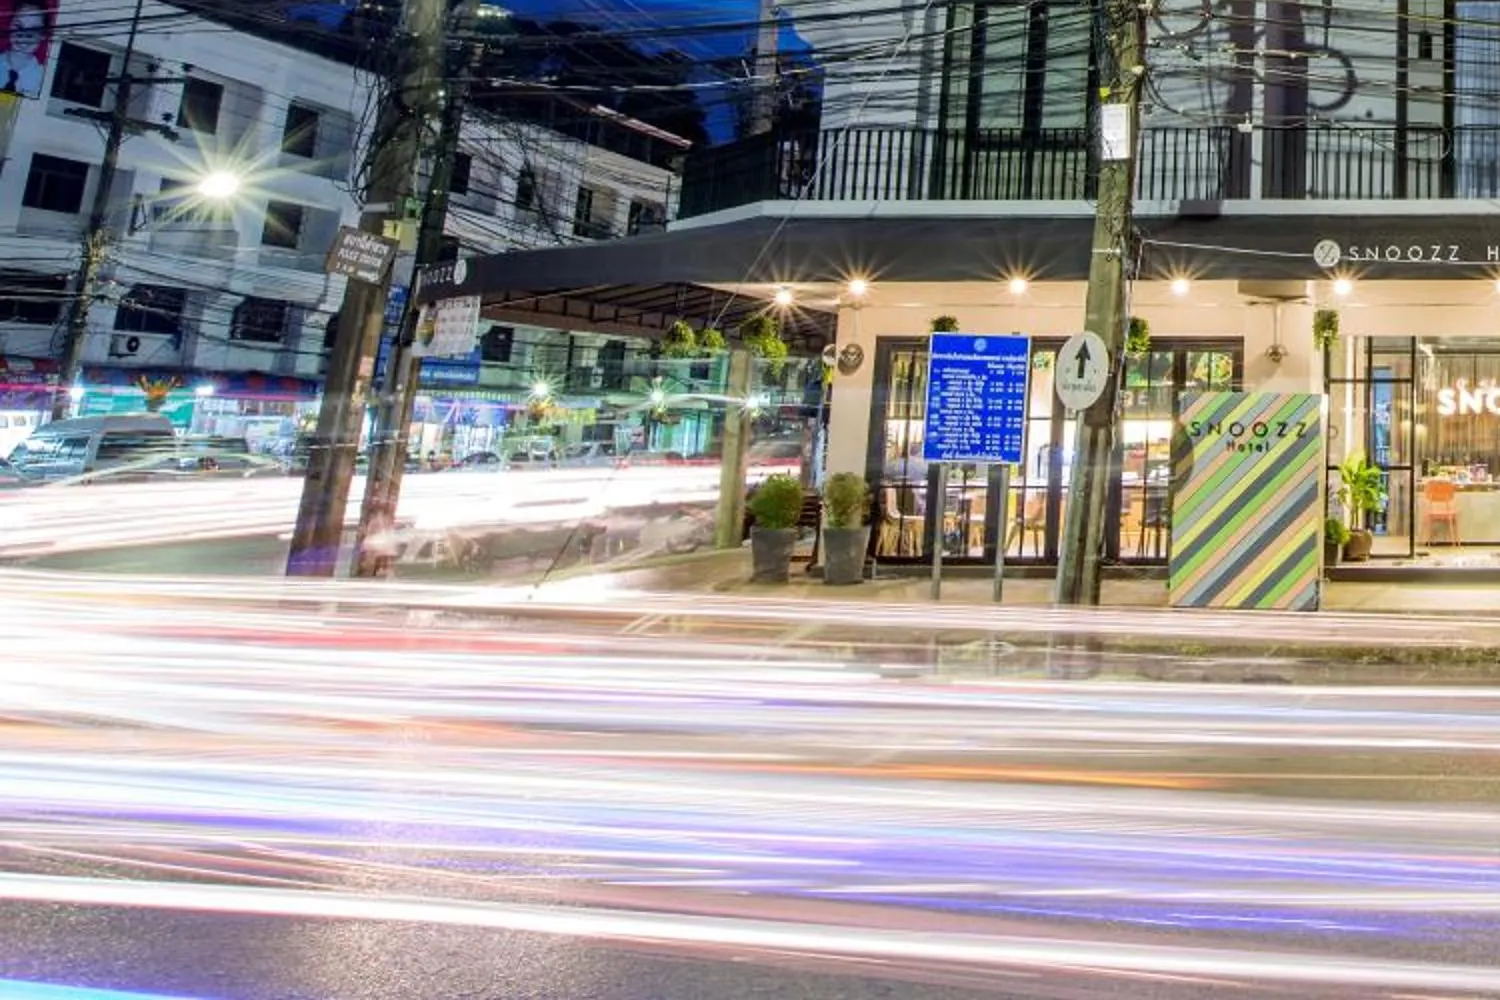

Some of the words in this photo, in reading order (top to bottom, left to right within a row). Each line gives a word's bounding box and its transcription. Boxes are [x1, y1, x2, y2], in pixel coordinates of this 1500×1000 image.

[1349, 245, 1460, 261] SNOOZZ
[1191, 421, 1307, 437] SNOOZZ
[1226, 441, 1269, 453] Hotel
